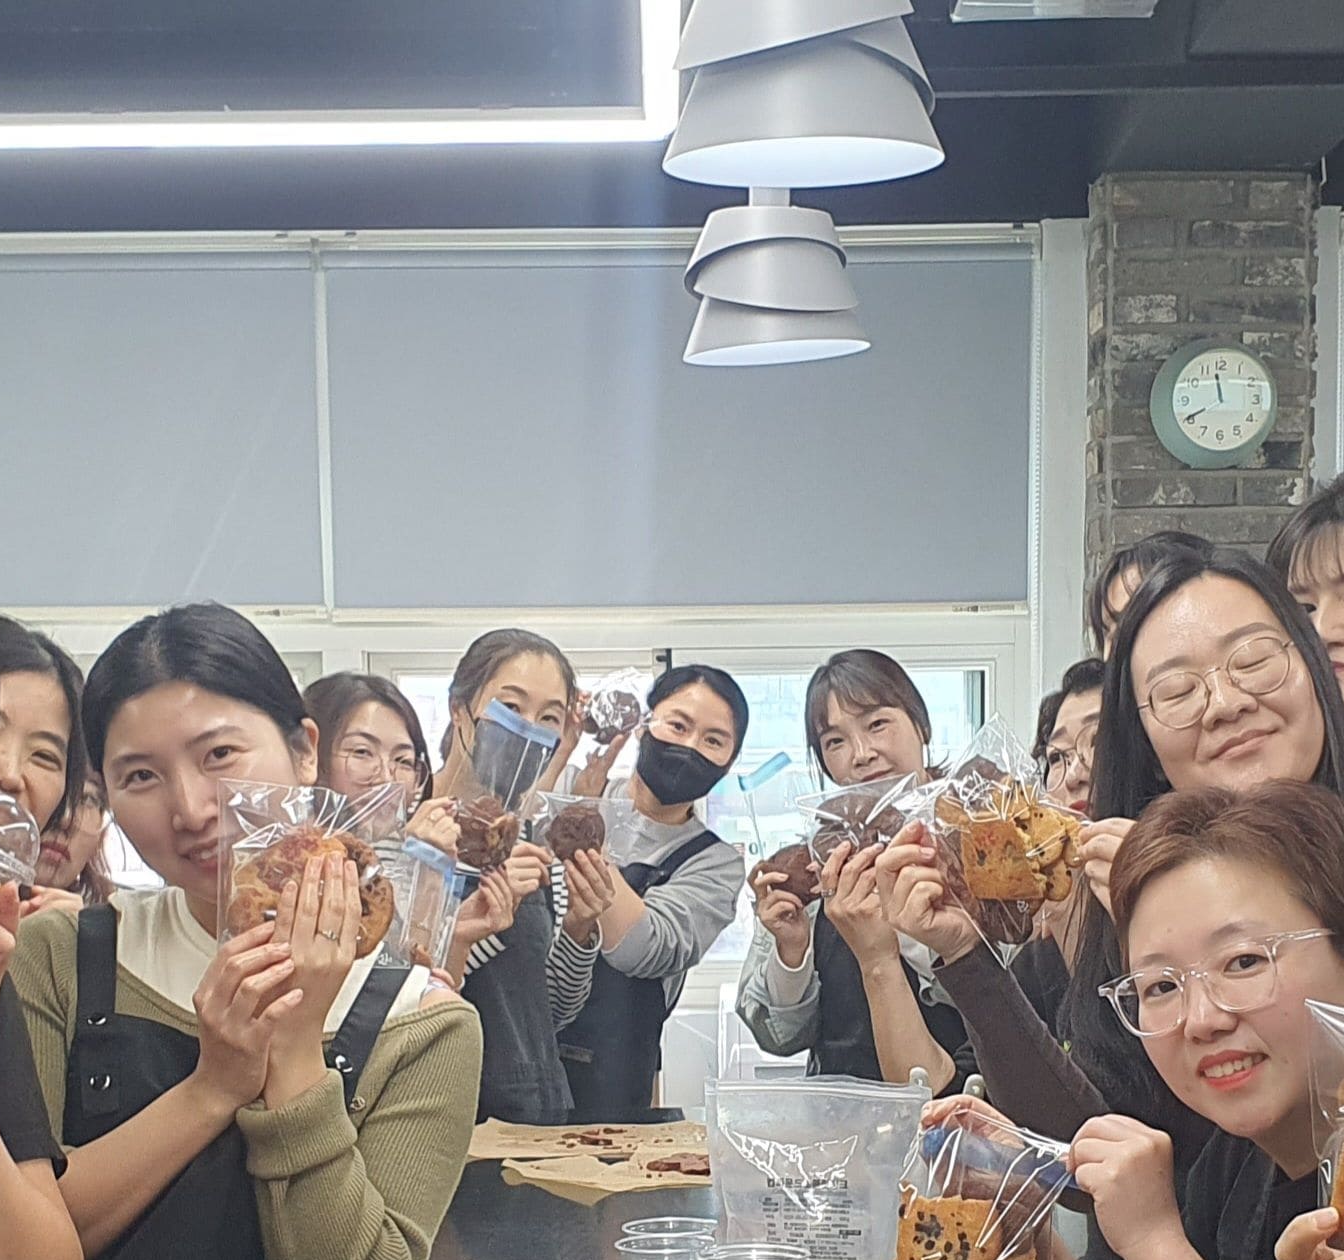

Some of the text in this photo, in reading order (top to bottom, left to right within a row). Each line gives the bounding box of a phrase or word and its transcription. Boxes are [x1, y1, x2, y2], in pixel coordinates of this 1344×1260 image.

[1201, 365, 1209, 375] 11
[1215, 360, 1227, 371] 12
[1187, 377, 1199, 388] 10
[1247, 376, 1256, 388] 2
[1180, 395, 1190, 406] 9
[1251, 394, 1261, 405] 3
[1245, 412, 1254, 423] 4
[1199, 425, 1208, 436] 7
[1215, 429, 1224, 441] 6
[1232, 425, 1241, 436] 5
